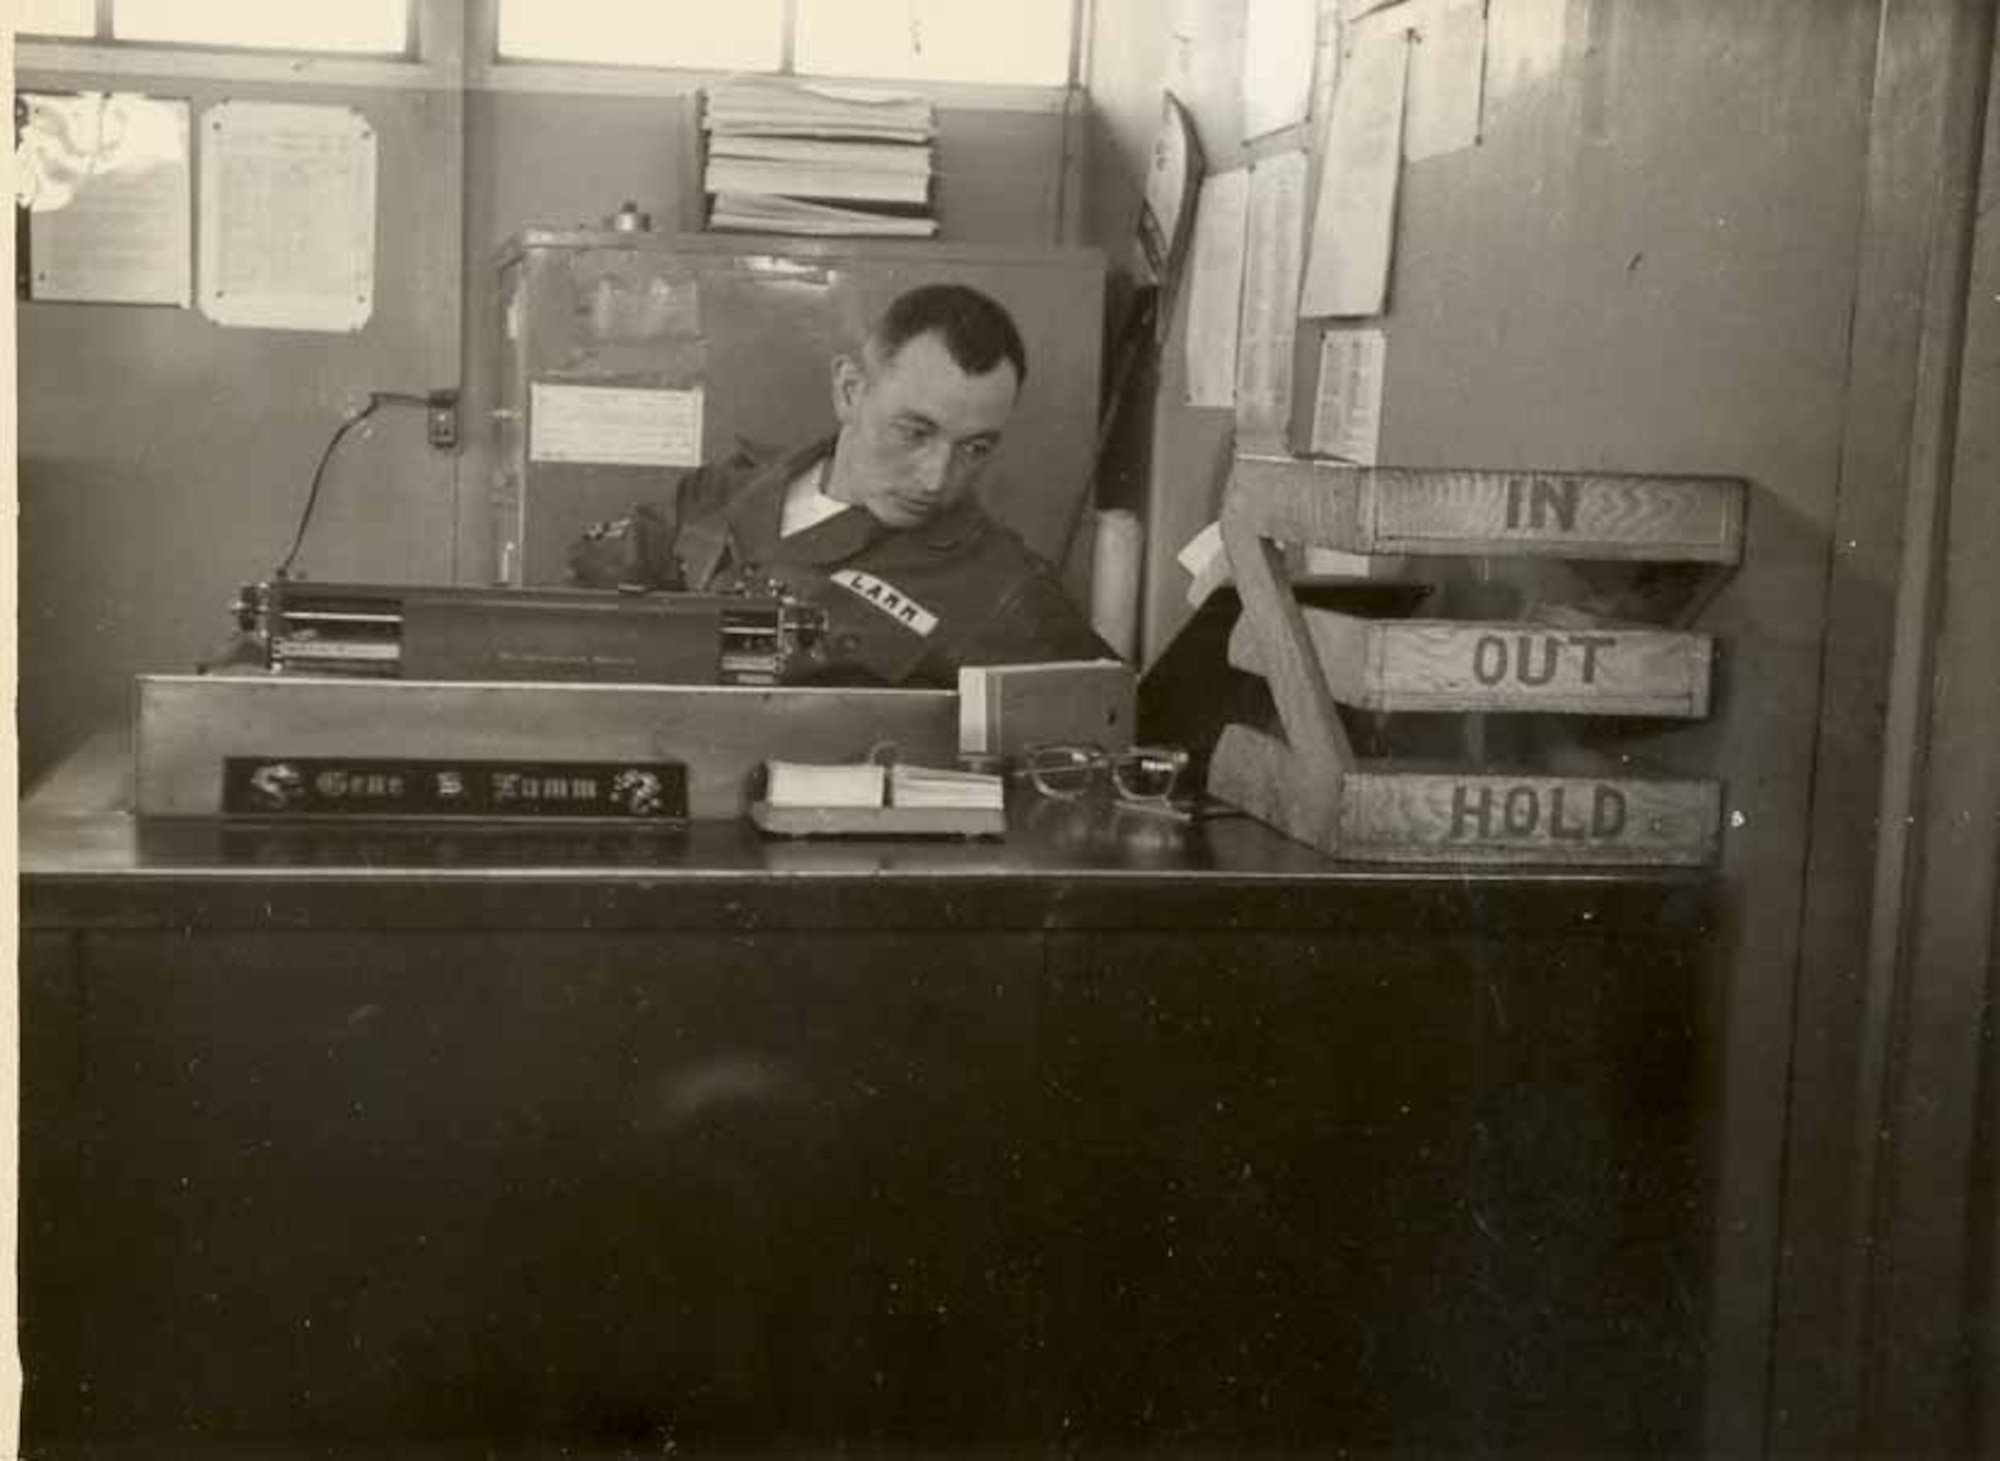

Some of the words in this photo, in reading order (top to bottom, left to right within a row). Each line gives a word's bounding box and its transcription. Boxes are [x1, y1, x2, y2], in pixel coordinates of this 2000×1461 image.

[1505, 479, 1580, 532] IN
[849, 575, 919, 622] LAMM
[1472, 635, 1617, 689] OUT
[1447, 784, 1628, 841] HOLD
